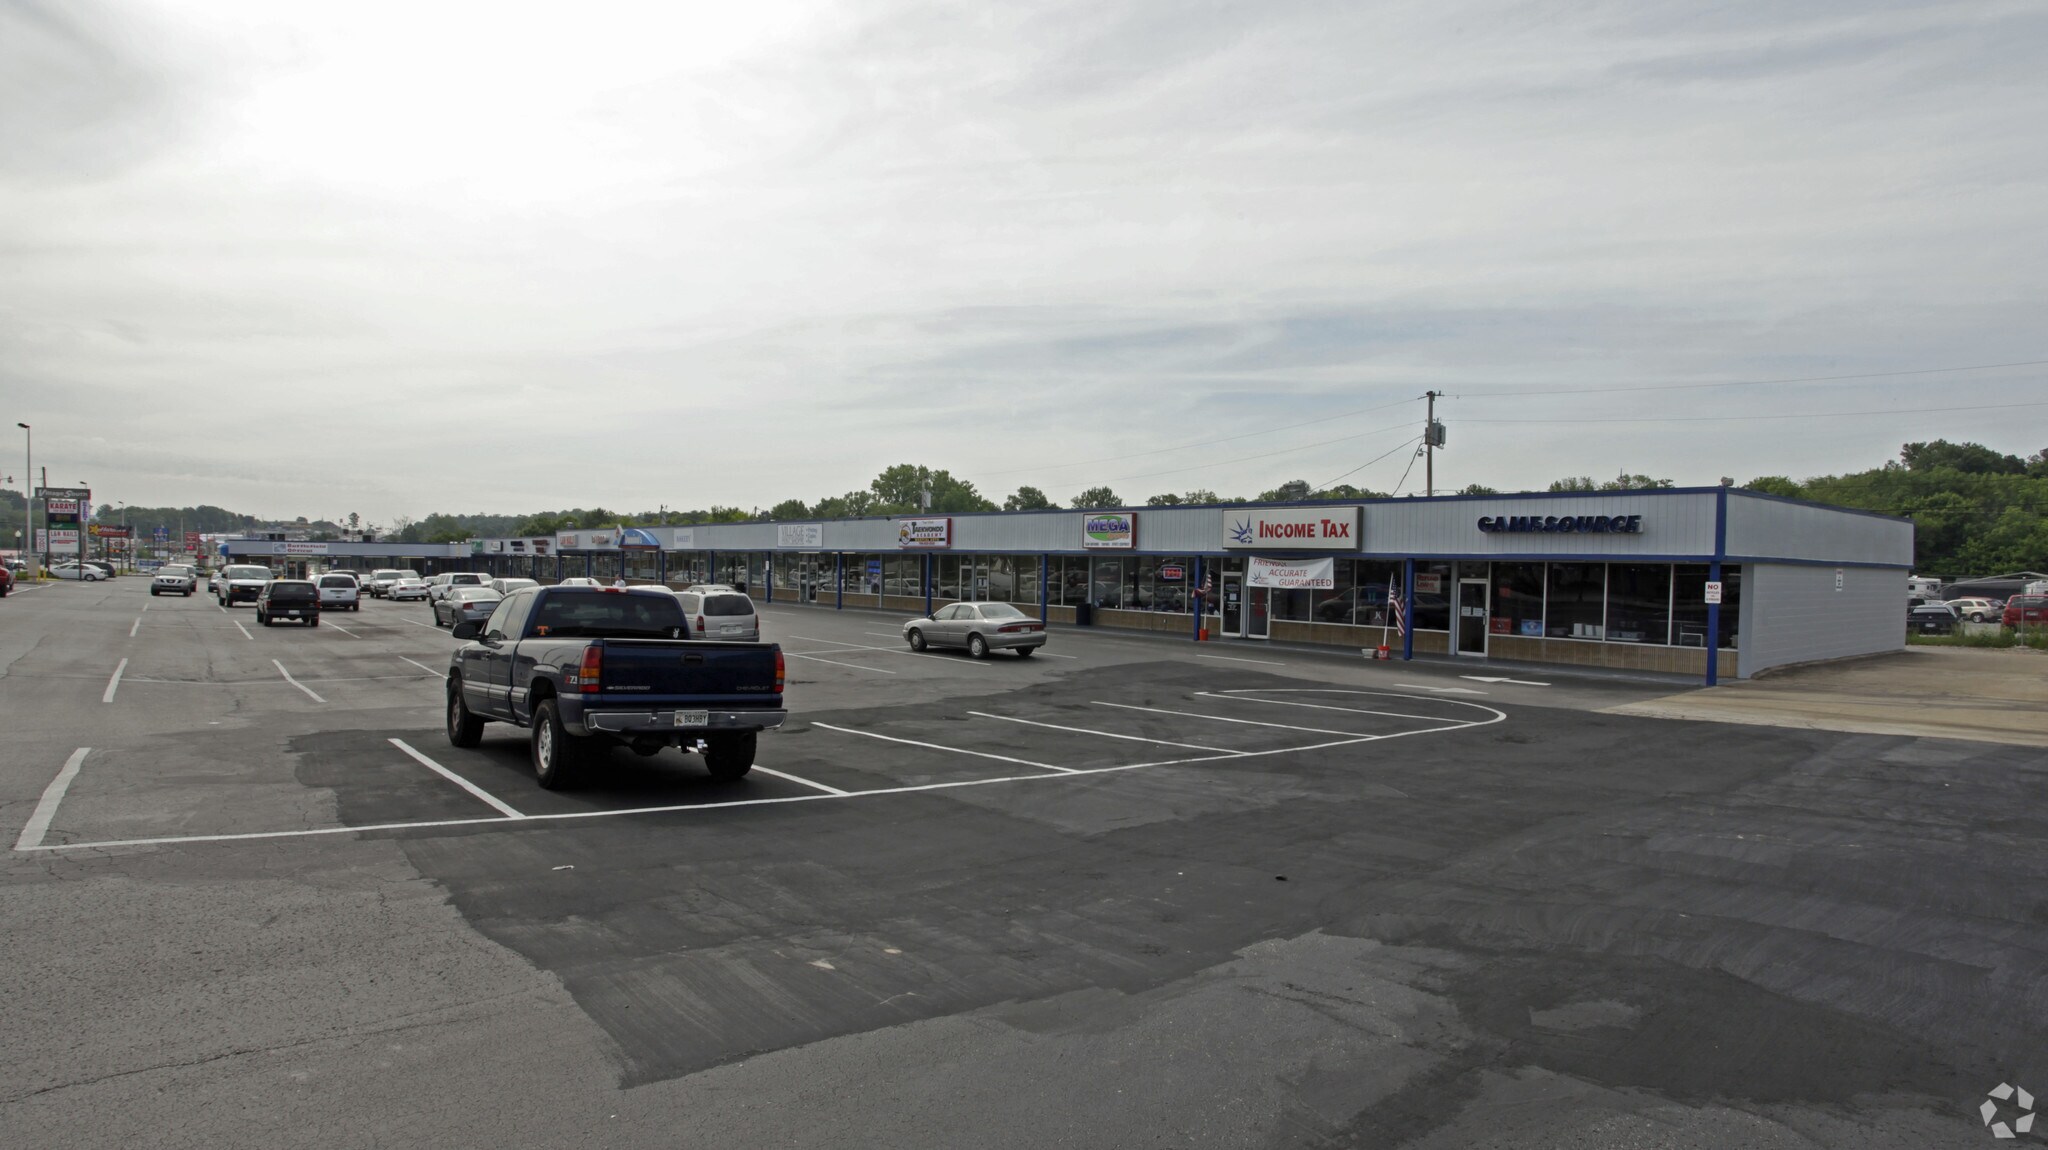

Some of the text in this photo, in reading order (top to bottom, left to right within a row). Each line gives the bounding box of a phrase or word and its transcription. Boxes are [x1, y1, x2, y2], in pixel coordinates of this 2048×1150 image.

[781, 525, 805, 536] VILLAGE
[1087, 518, 1130, 533] MEGA
[1259, 519, 1350, 538] INCOME TAX
[1477, 515, 1643, 534] GAMESOURCE
[1268, 568, 1308, 577] ACCURATE
[1278, 578, 1332, 587] GUARANTEED
